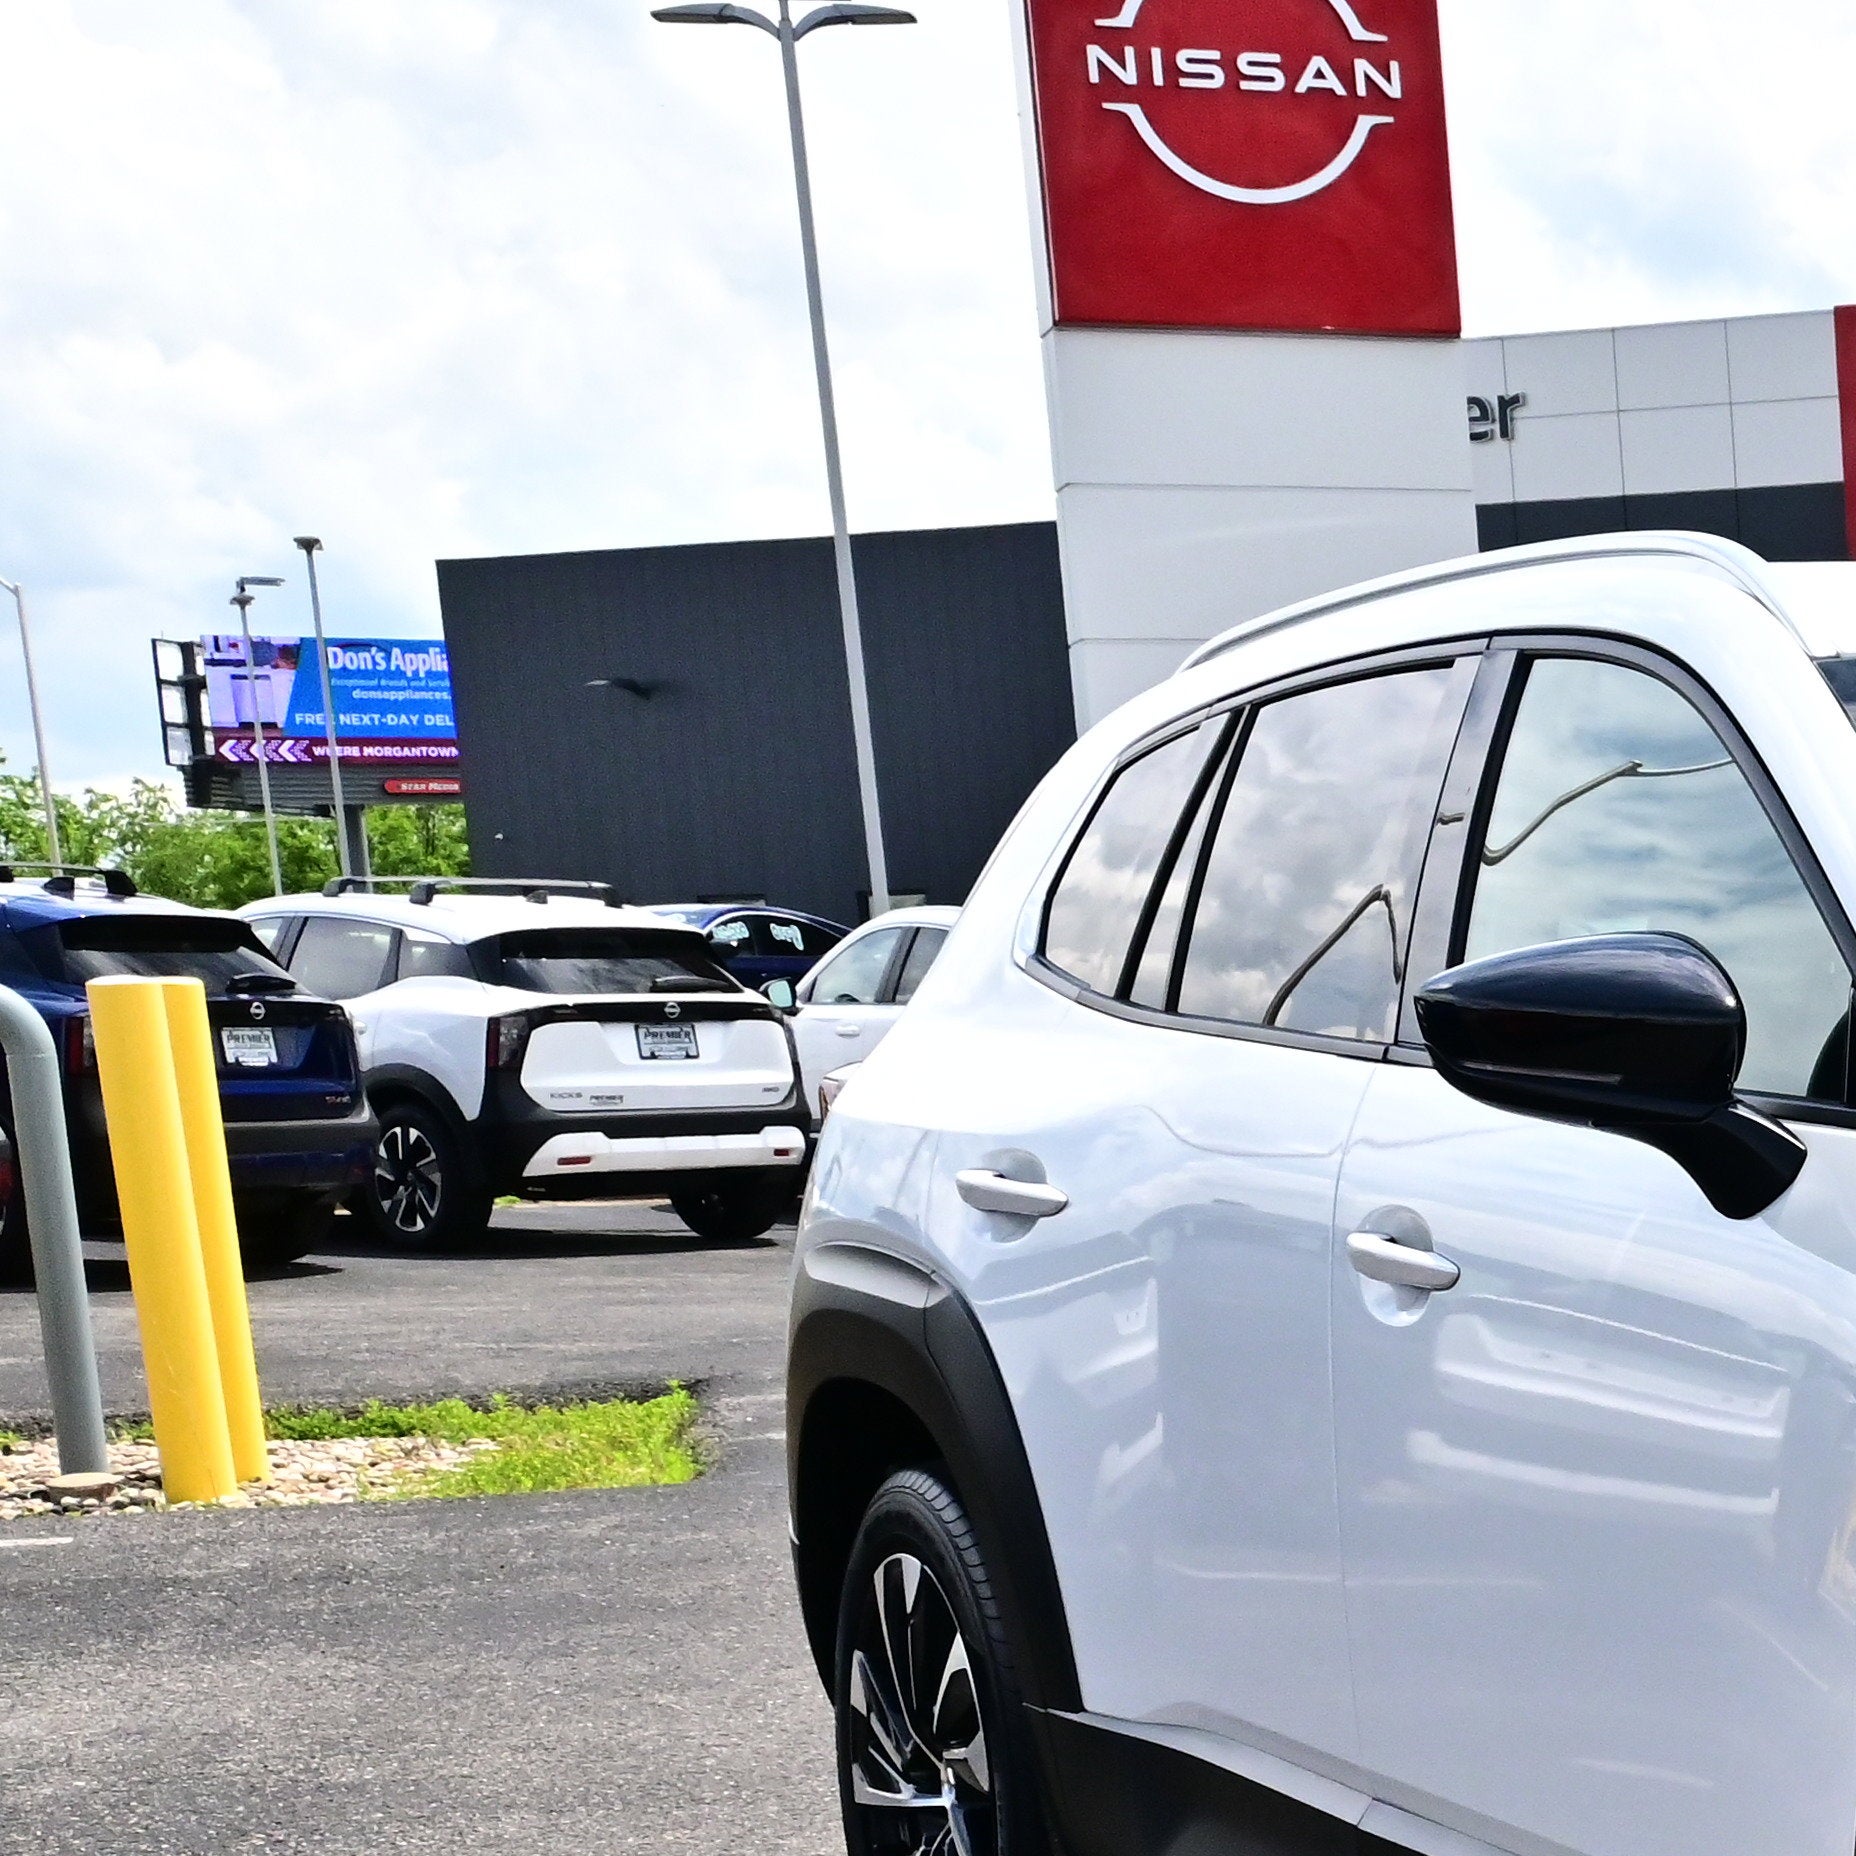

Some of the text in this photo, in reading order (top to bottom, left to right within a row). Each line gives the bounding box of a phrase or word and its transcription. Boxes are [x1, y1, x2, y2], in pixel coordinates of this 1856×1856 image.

[1086, 44, 1402, 99] NISSAN
[327, 646, 387, 671] Don's
[295, 713, 336, 726] FRE
[339, 713, 419, 726] NEXT-DAY
